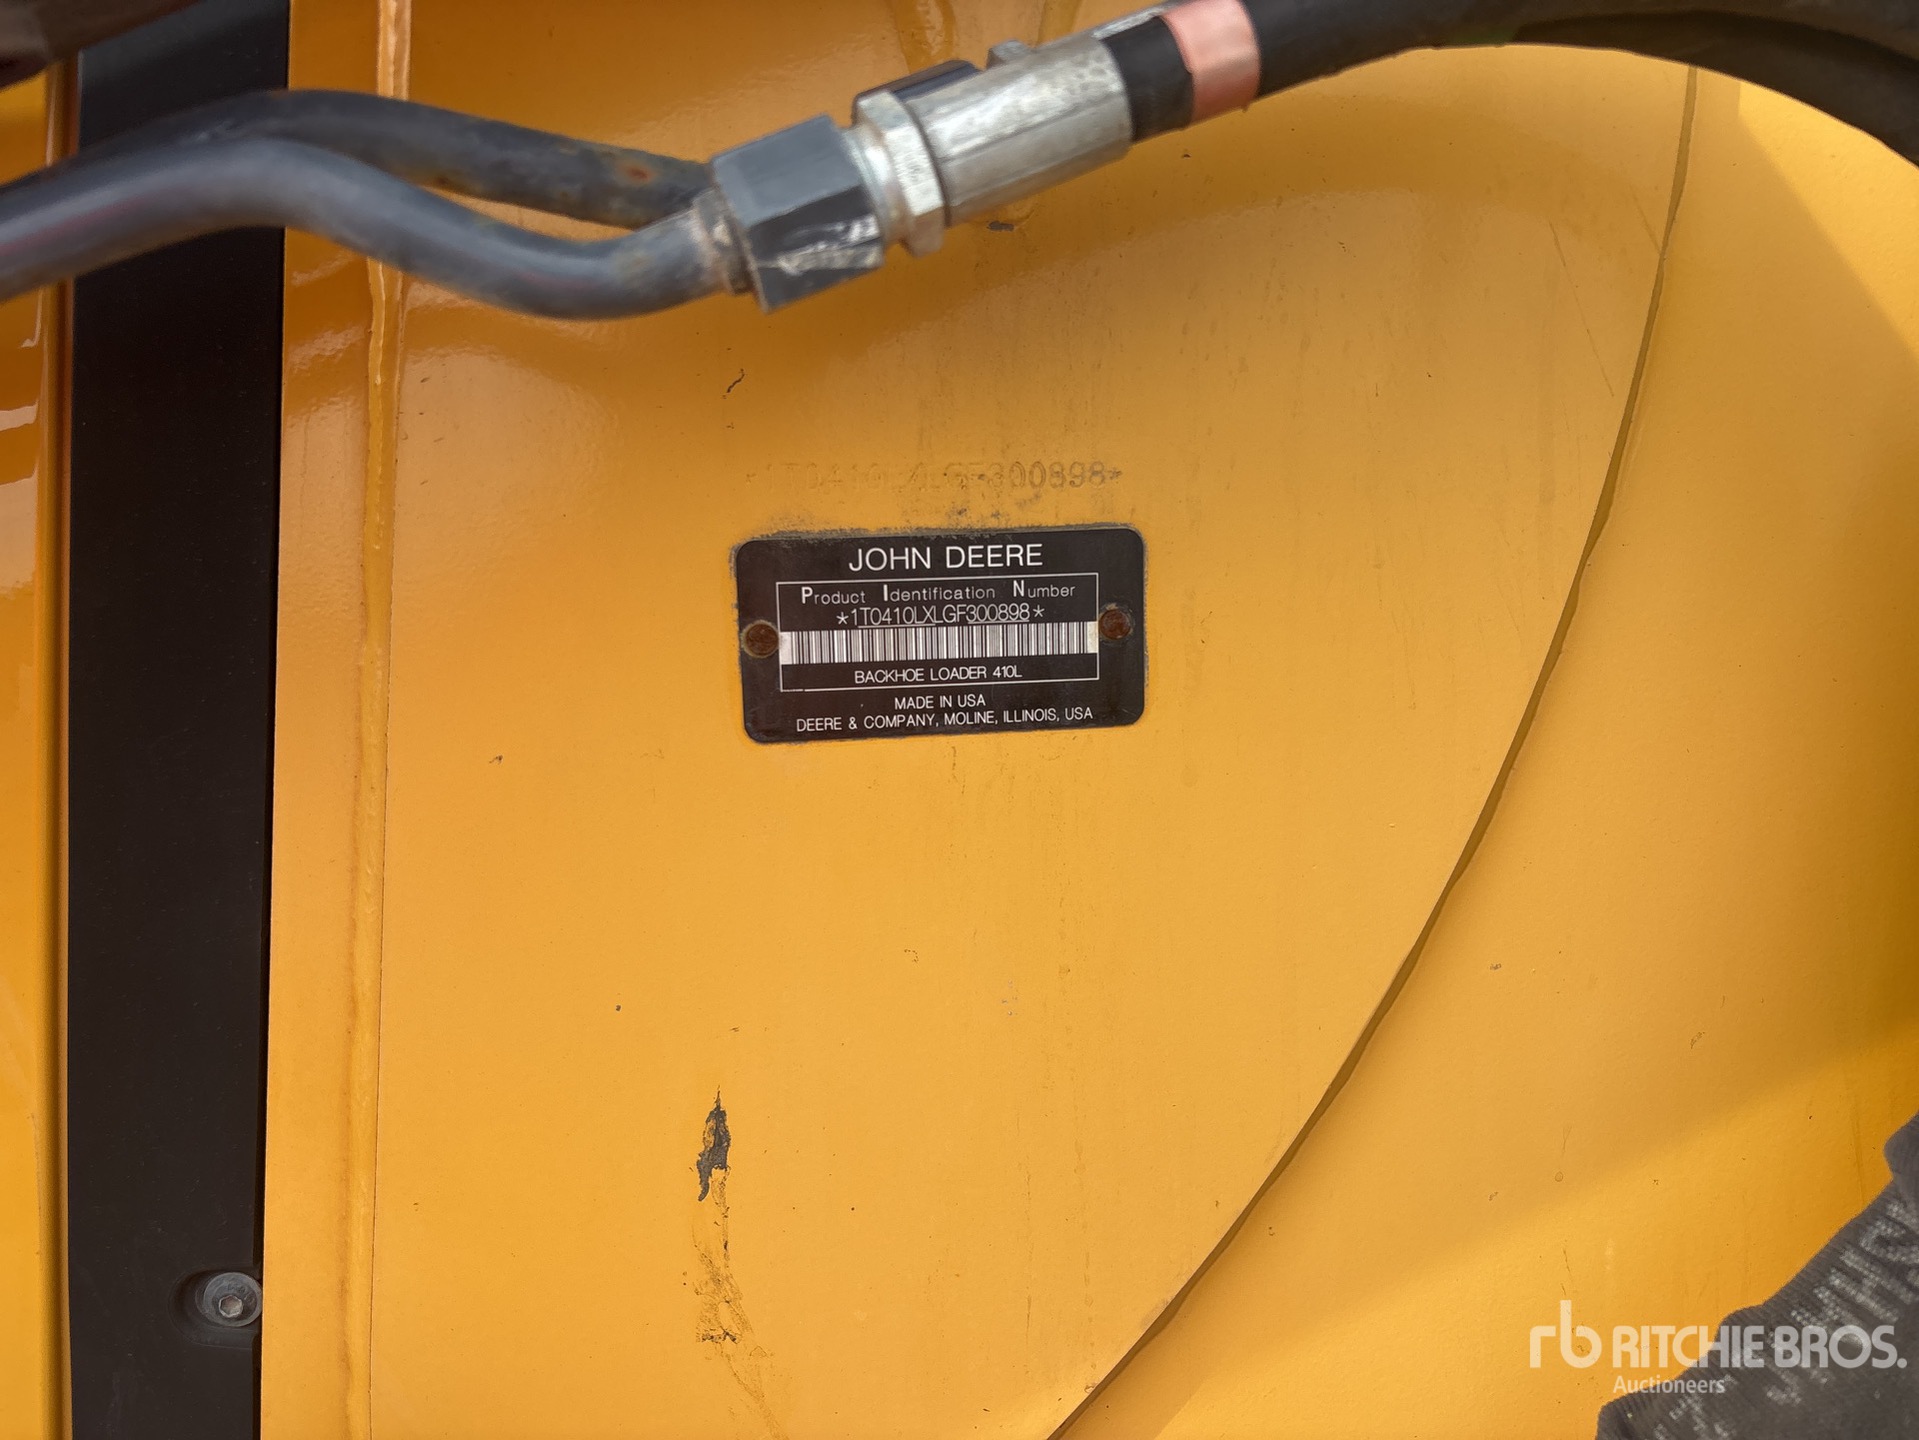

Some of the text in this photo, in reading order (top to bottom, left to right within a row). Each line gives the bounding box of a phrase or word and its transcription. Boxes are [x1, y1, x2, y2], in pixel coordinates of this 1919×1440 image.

[848, 542, 1044, 572] JOHN DEERE
[801, 579, 1076, 605] Product Identification Number
[854, 664, 1023, 684] BACKHOE LOADER 410L
[894, 693, 986, 710] MADE IN USA
[796, 706, 1093, 732] DEERE & COMPANY, MOLINE, ILLINOIS, USA
